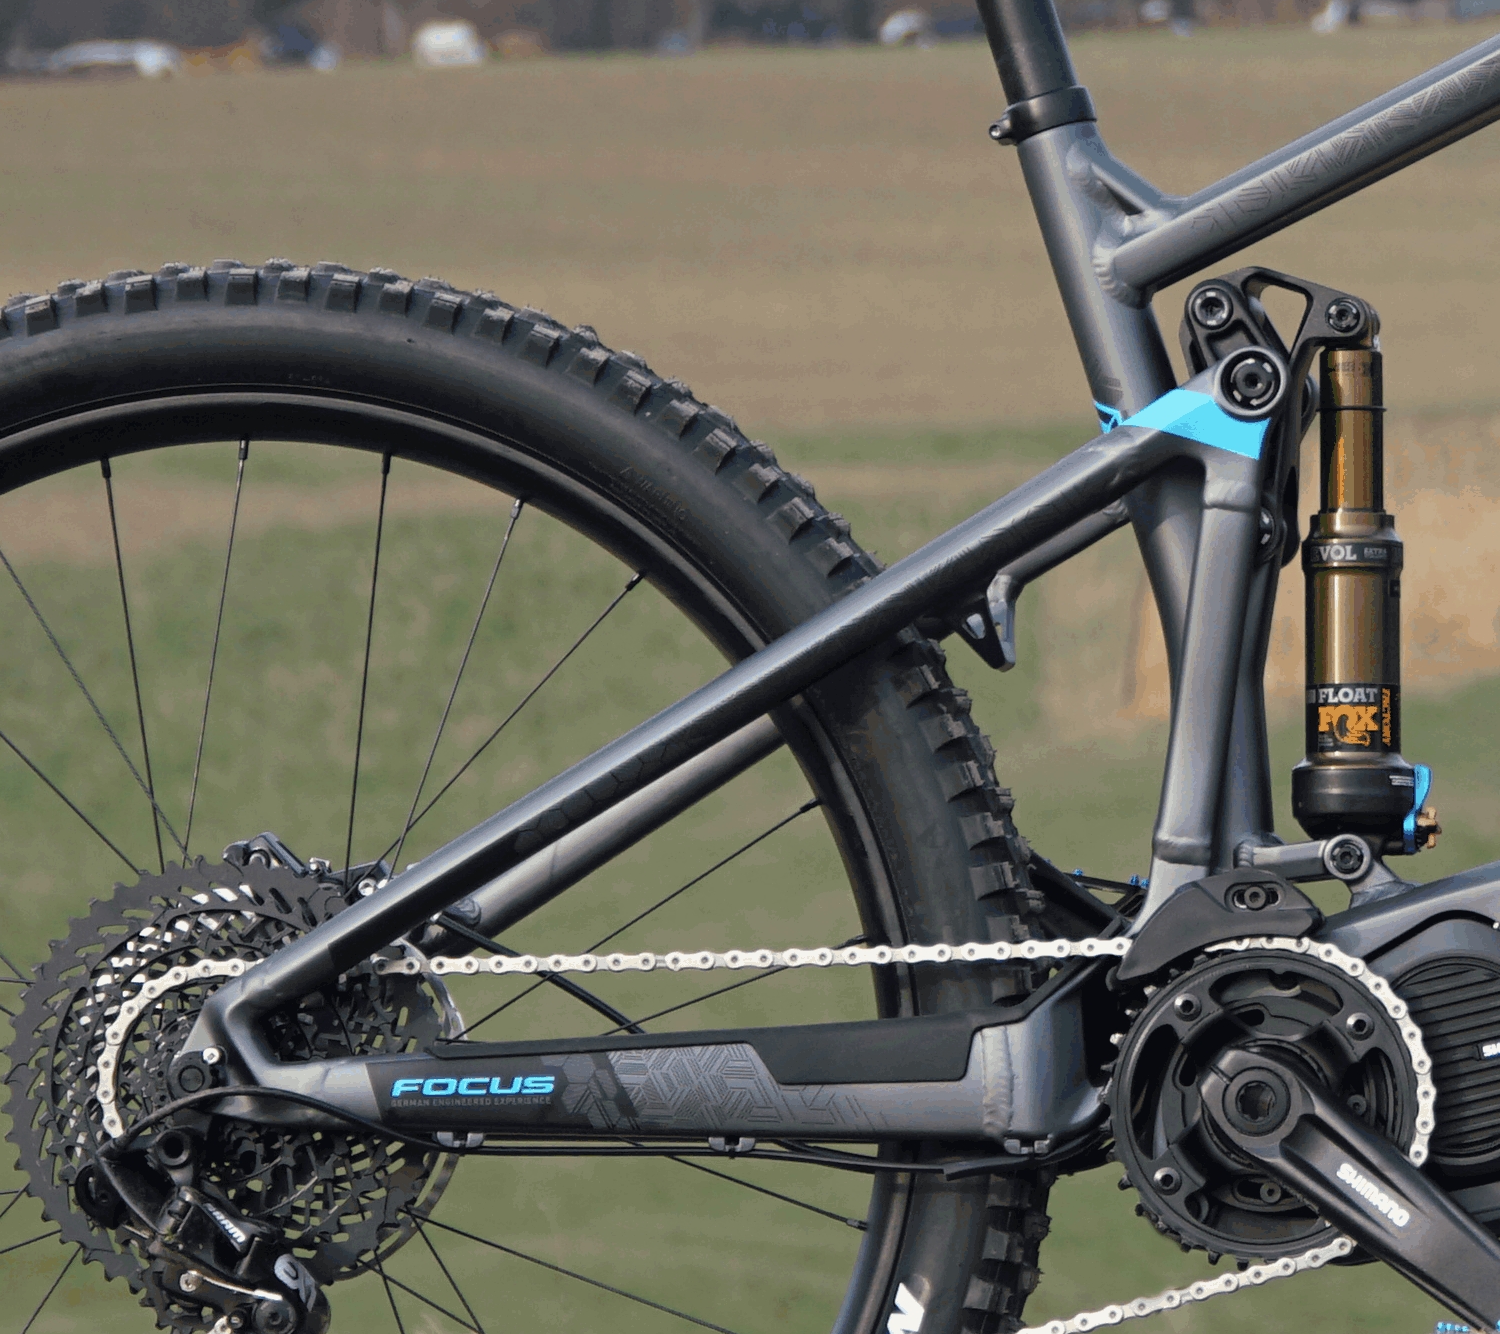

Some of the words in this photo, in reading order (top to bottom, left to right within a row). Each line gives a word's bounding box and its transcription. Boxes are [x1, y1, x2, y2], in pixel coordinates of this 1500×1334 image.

[1318, 687, 1378, 703] FLOAT
[1318, 704, 1379, 740] FOX
[391, 1076, 555, 1097] FOCUS
[1335, 1160, 1411, 1229] SHIMANO
